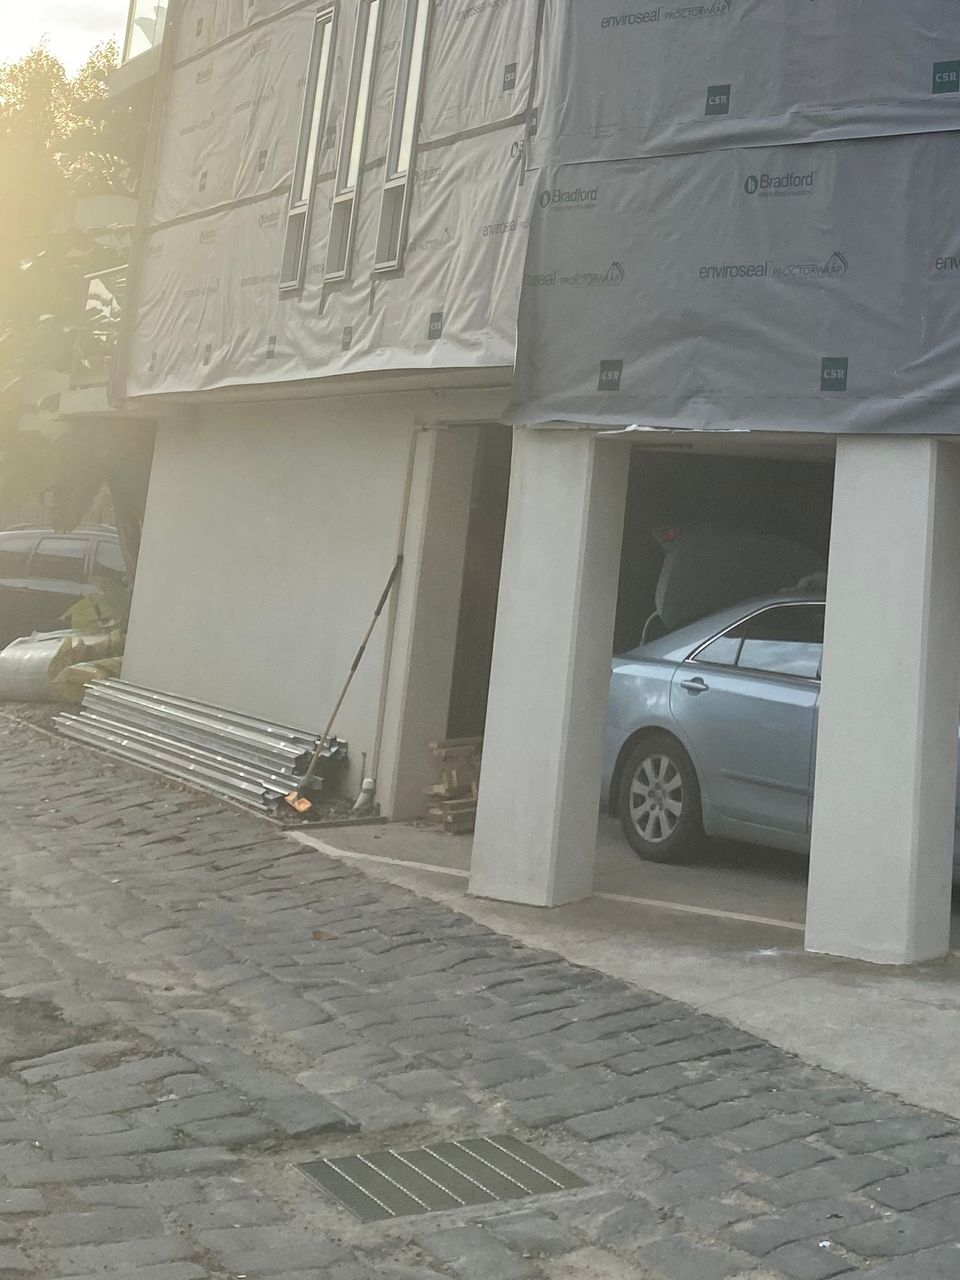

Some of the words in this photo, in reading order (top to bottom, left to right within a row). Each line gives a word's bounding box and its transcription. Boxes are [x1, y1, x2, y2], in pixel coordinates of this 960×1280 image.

[601, 7, 660, 28] enviroseal
[935, 71, 957, 82] CSR
[708, 94, 727, 105] CSR
[760, 171, 813, 188] Bradford
[551, 187, 598, 204] Bradford
[699, 261, 768, 279] enviroseal
[602, 370, 620, 380] CSR
[823, 369, 845, 380] CSR
